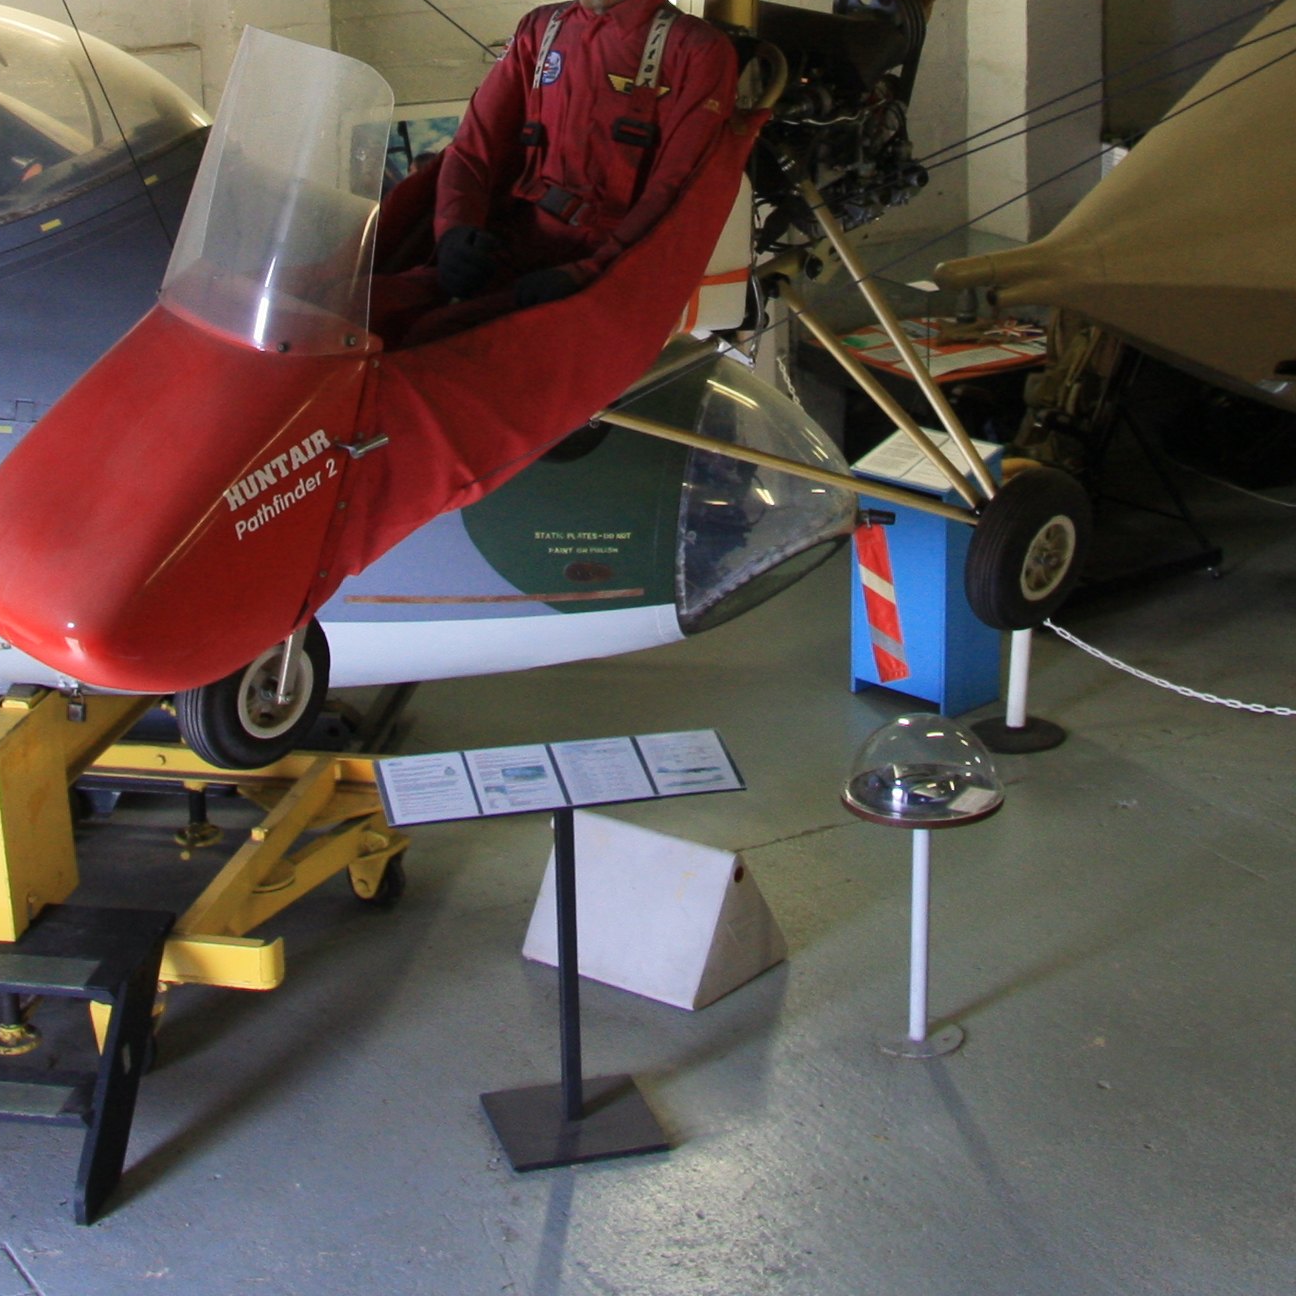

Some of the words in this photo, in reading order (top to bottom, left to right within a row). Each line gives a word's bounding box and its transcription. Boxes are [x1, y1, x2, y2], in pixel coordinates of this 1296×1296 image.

[223, 429, 331, 512] HUNTAIR
[234, 470, 322, 541] Pathfinder
[325, 458, 338, 478] 2
[534, 531, 564, 540] STATIC
[616, 531, 632, 540] NOT
